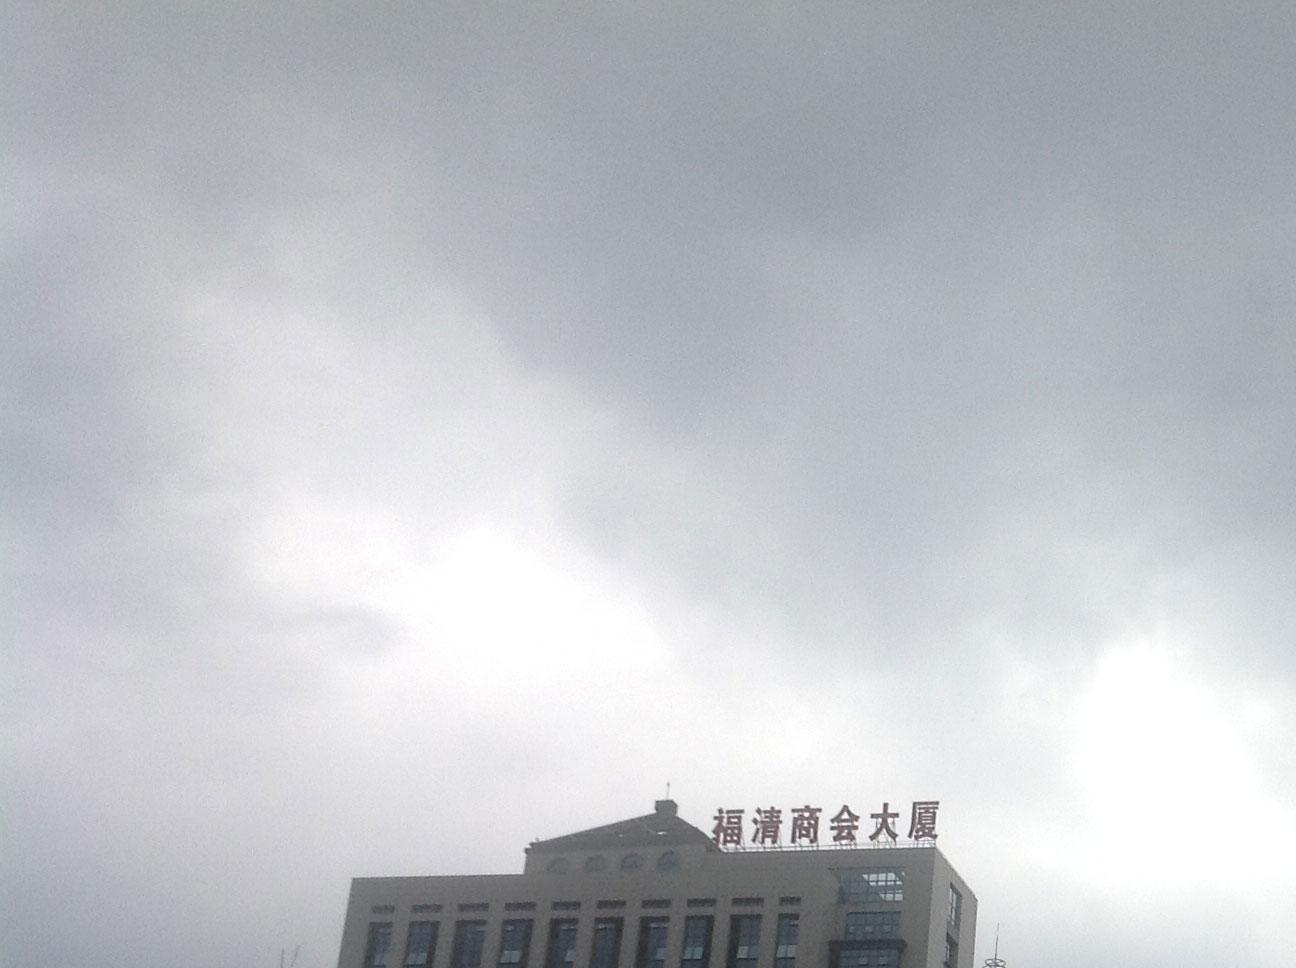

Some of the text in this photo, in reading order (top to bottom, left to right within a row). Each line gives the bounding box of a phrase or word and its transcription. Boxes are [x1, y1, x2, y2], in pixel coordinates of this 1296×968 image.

[711, 800, 940, 846] 福清商会大厦
